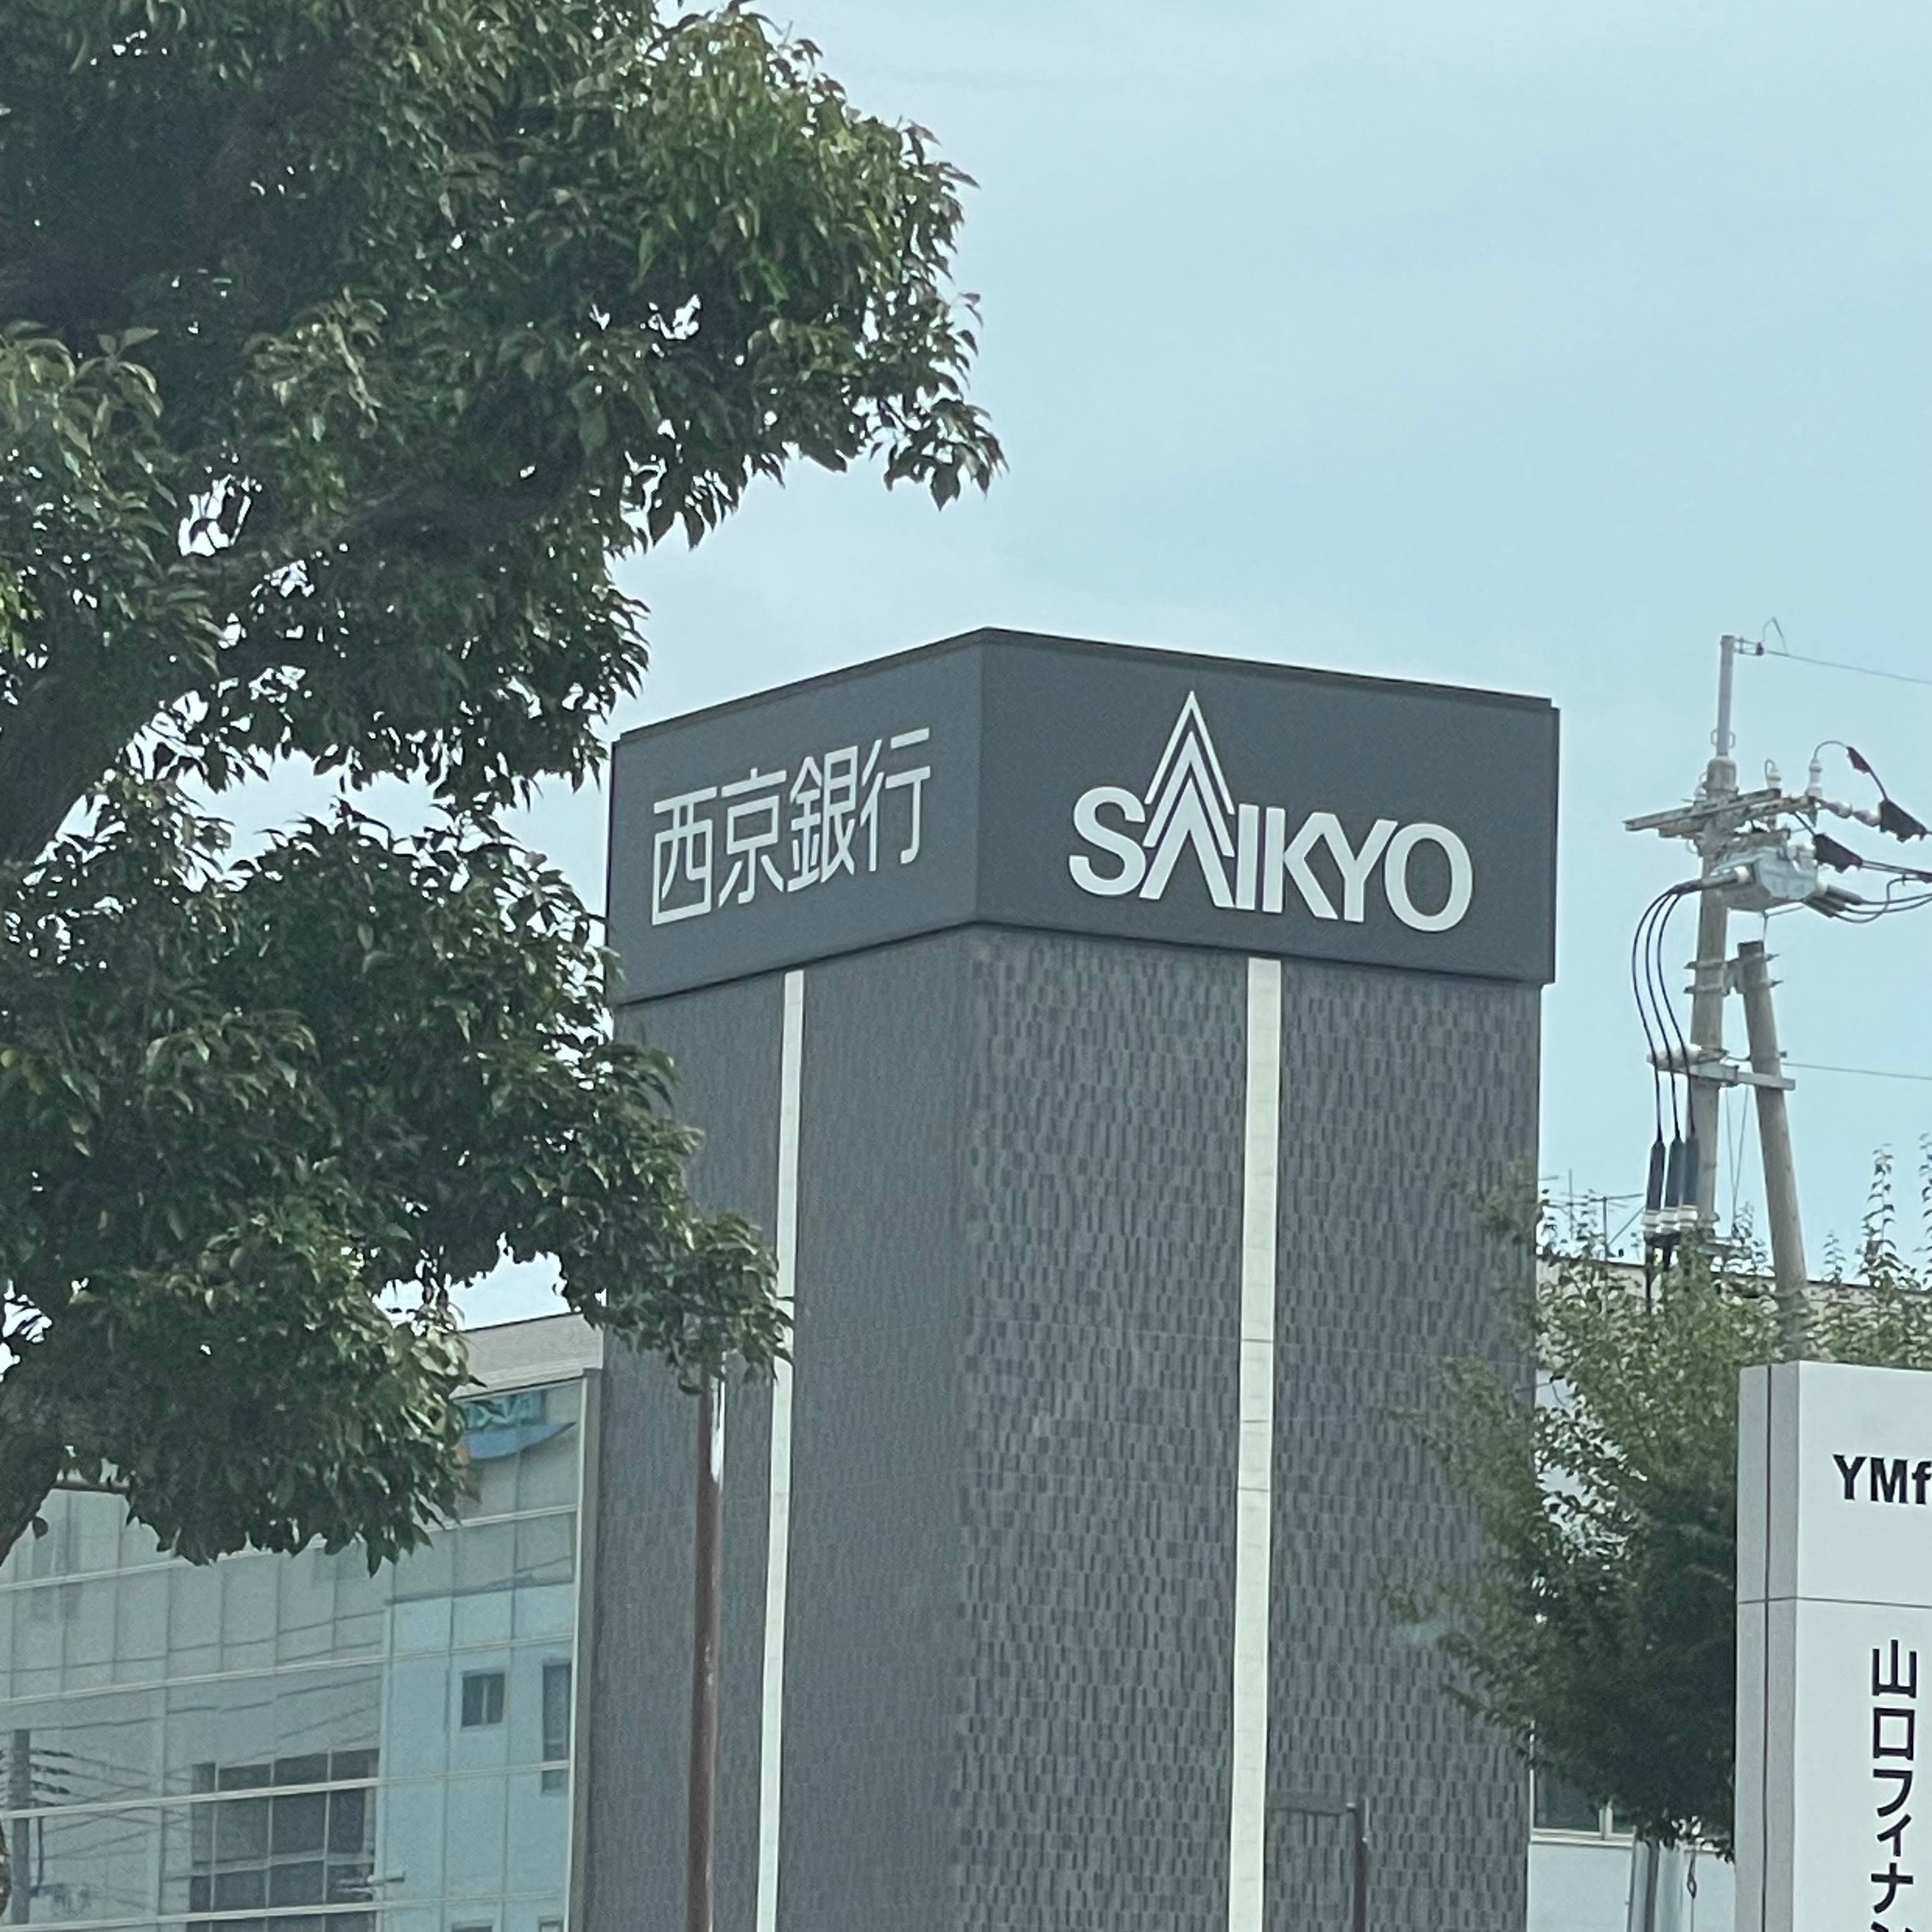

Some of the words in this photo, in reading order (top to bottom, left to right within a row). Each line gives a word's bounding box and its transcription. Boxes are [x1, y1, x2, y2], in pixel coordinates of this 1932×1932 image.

[652, 728, 931, 926] 西京銀行
[1069, 690, 1473, 933] SAIKYO
[1871, 1639, 1917, 1932] 山口フィナ
